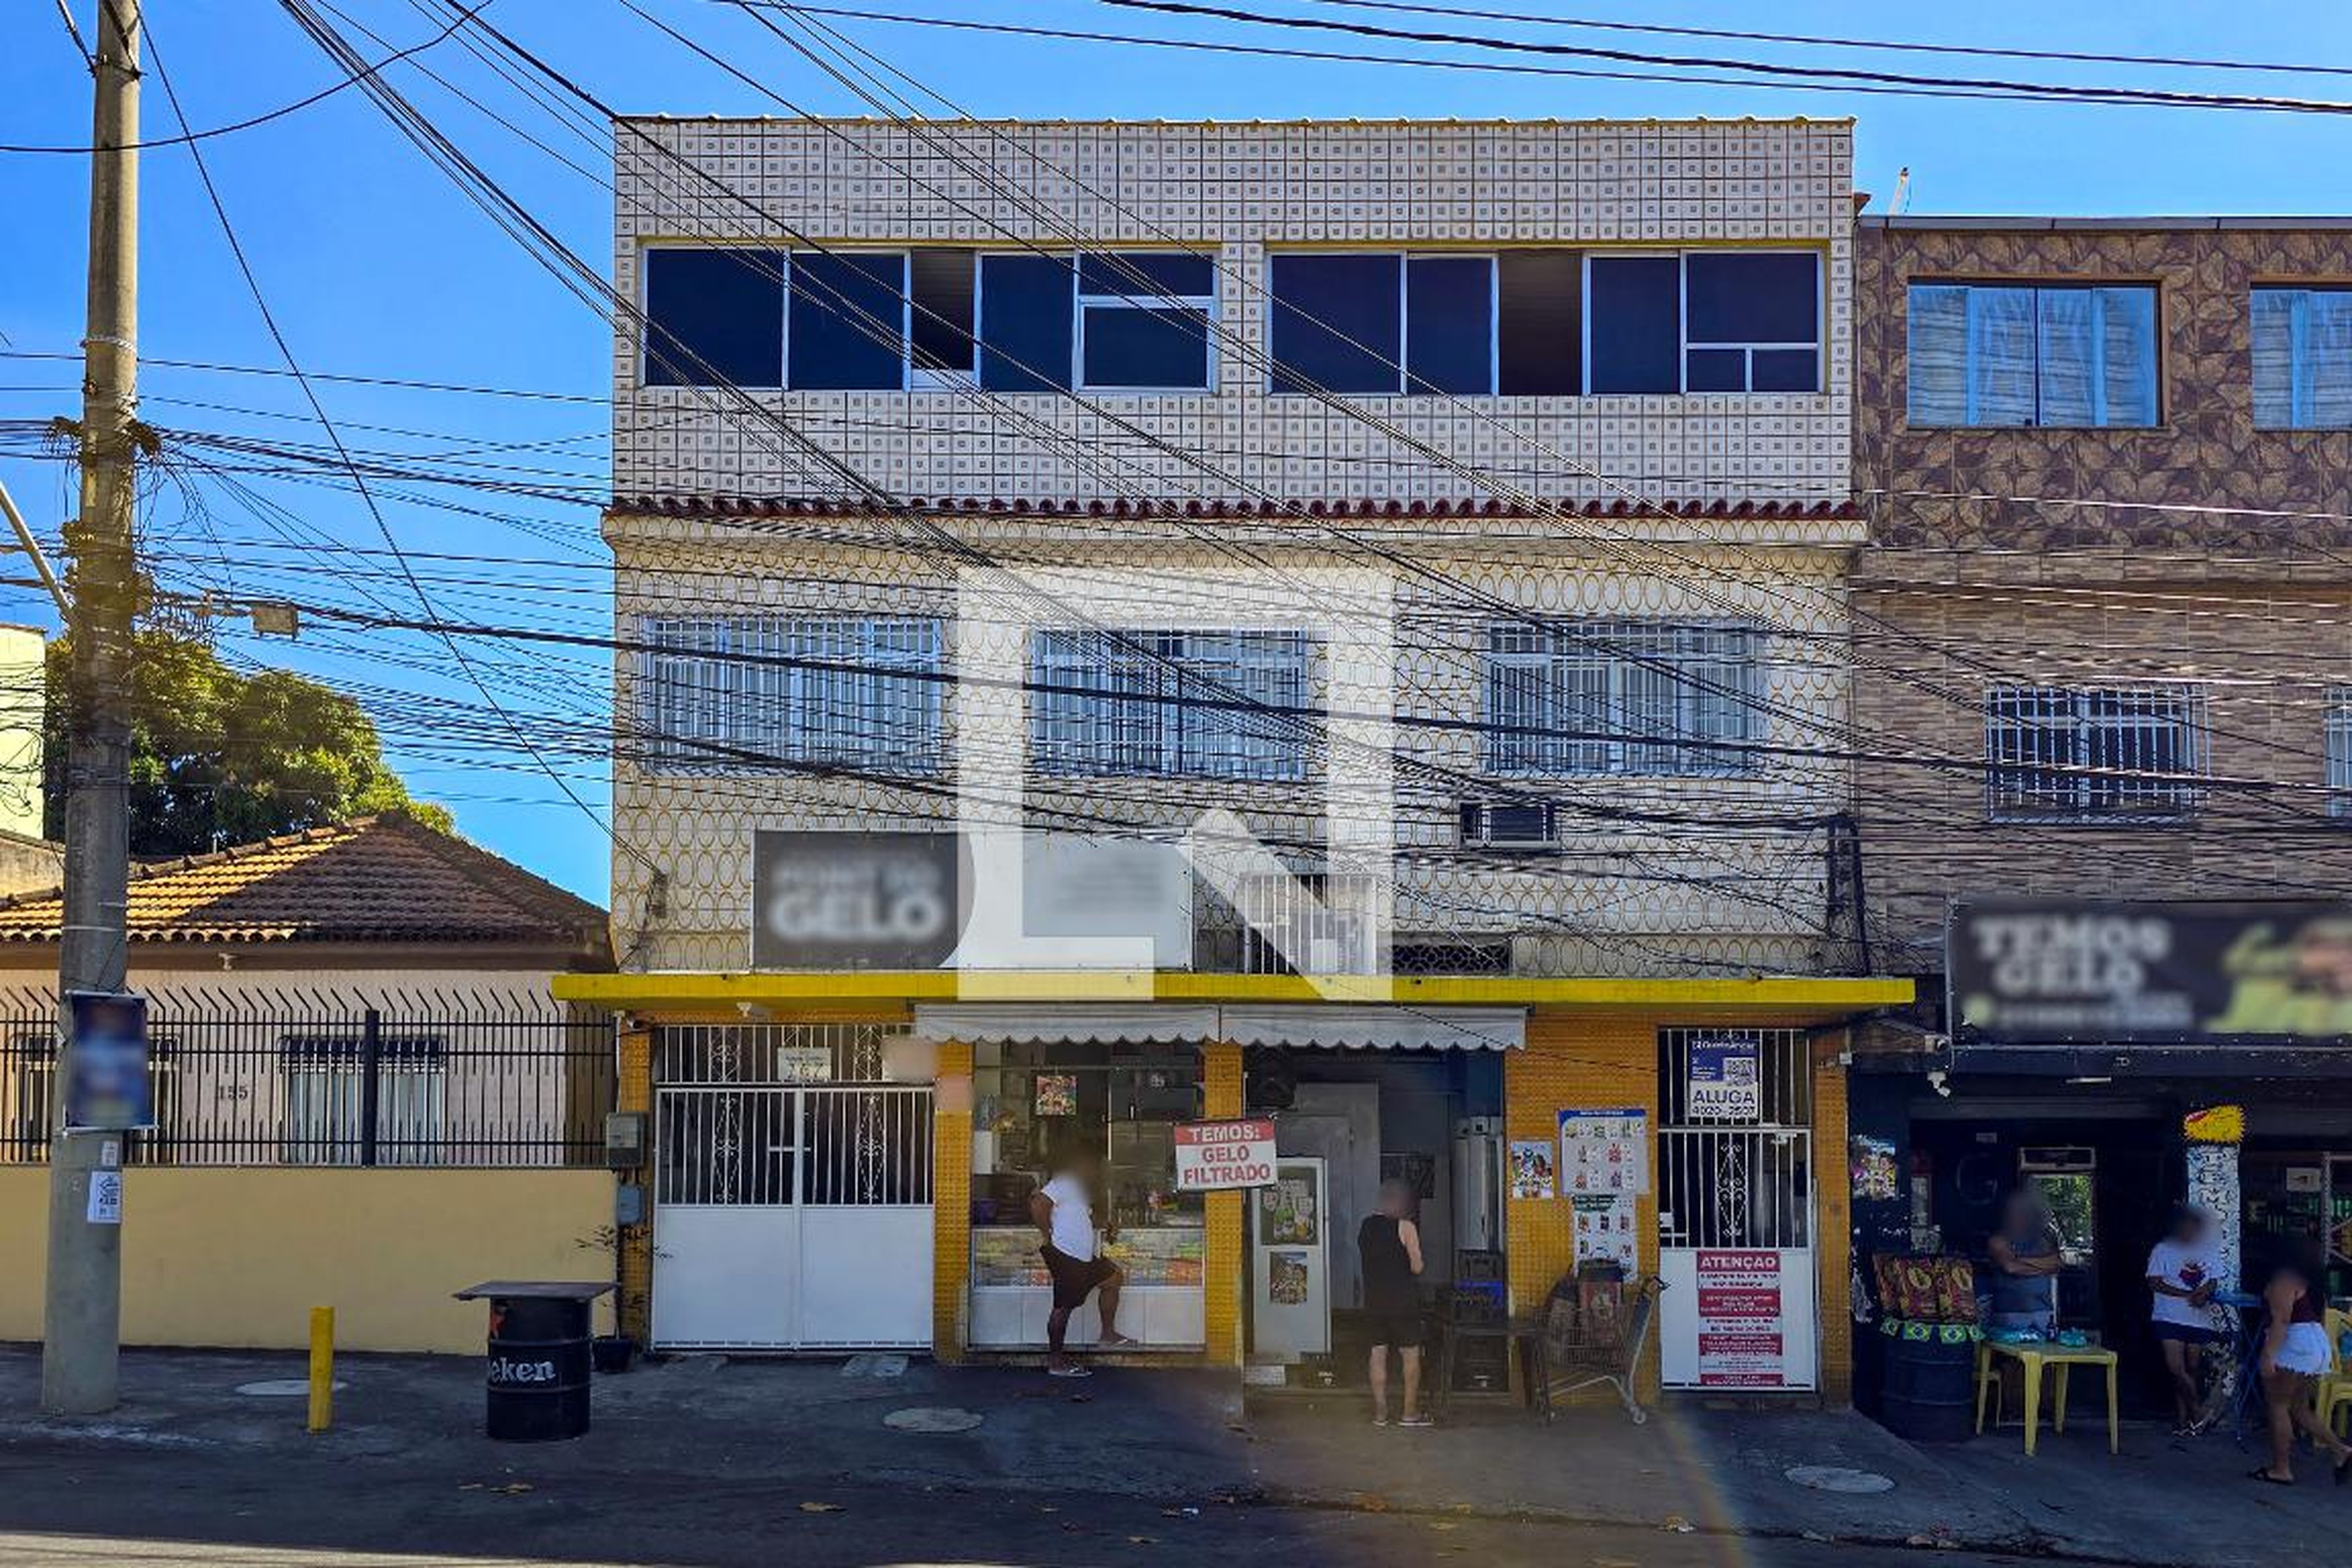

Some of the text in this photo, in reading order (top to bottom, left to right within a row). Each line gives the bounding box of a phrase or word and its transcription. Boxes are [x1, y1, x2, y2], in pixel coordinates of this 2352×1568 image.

[1692, 1090, 1755, 1103] ALUGA
[1189, 1125, 1259, 1142] TEMOS:
[1202, 1145, 1250, 1162] GELO
[1184, 1164, 1270, 1184] FILTRADO
